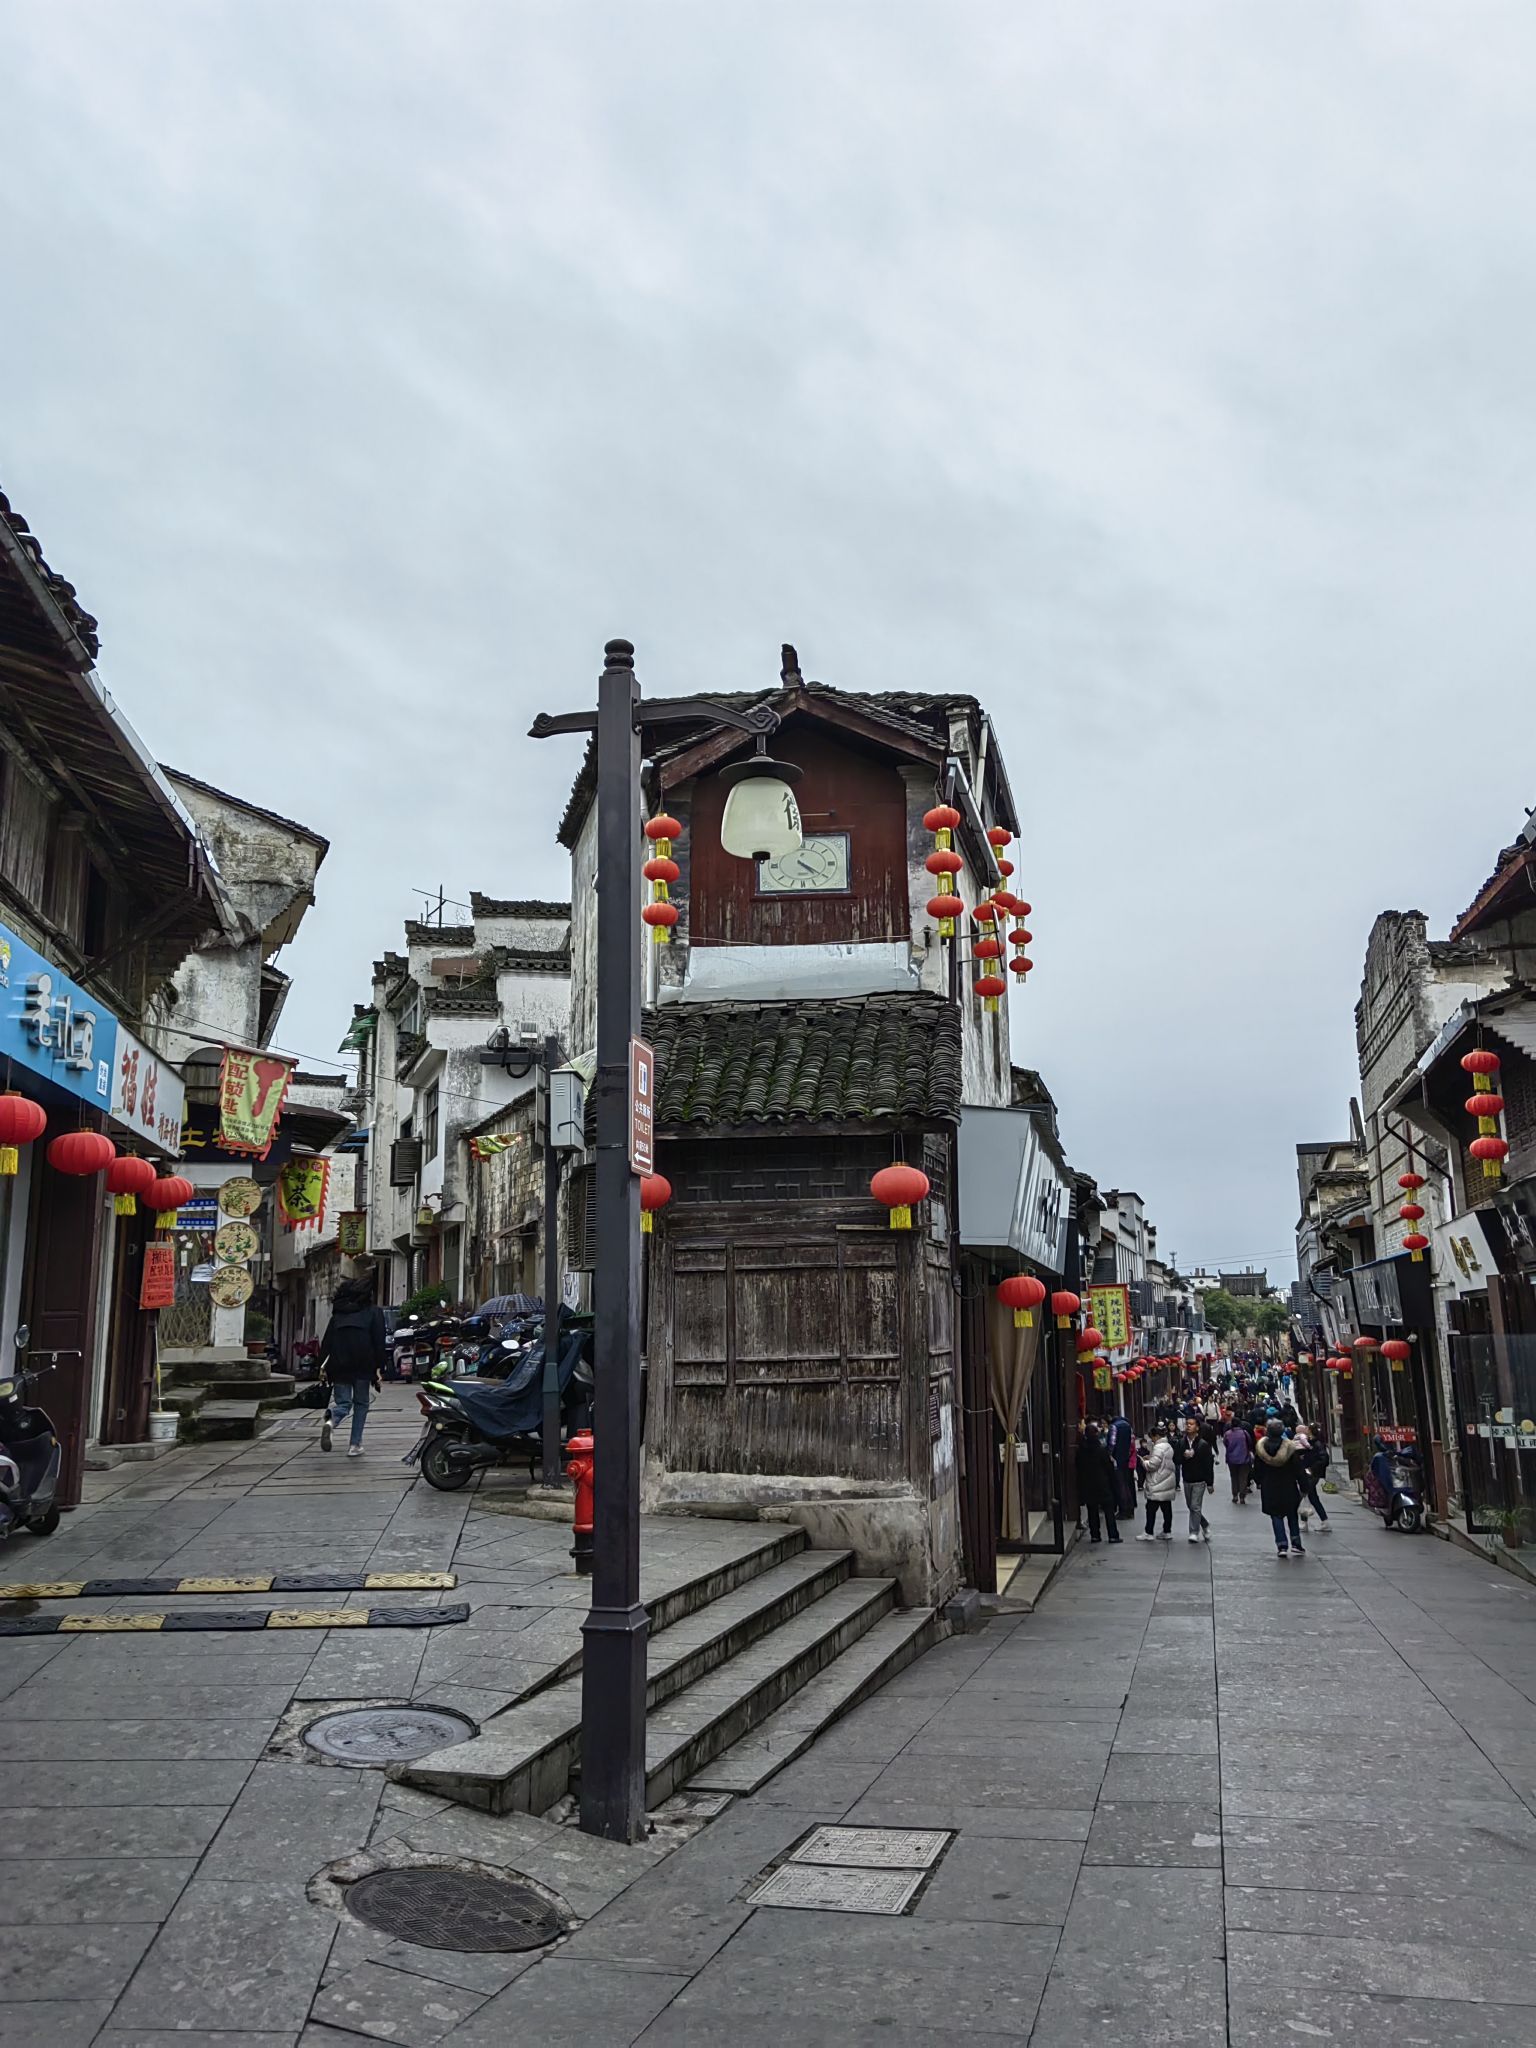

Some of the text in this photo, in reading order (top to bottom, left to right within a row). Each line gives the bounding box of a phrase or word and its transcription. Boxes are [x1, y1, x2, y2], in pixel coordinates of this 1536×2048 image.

[121, 1042, 158, 1129] 福娃
[634, 1099, 651, 1120] 公共厕所
[634, 1117, 651, 1136] TOILET
[286, 1183, 312, 1208] 茶
